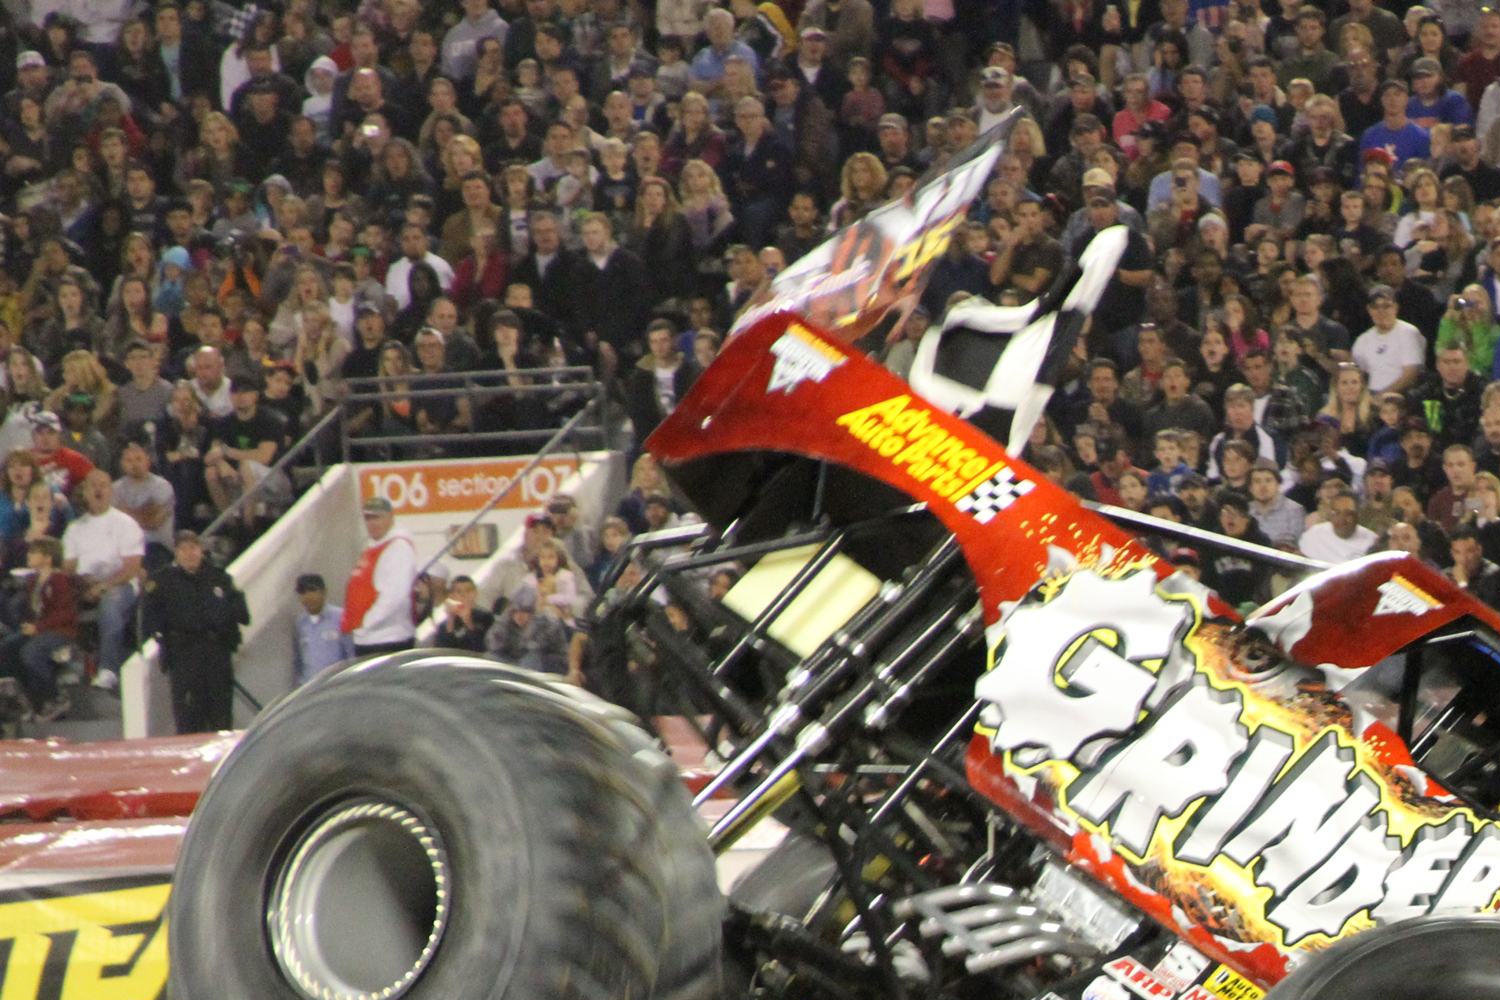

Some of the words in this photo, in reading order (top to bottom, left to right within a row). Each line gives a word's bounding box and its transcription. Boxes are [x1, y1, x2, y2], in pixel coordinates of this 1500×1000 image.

[835, 409, 907, 458] Auto
[891, 432, 967, 498] Parts
[863, 393, 989, 481] Advance
[369, 471, 428, 509] 106
[437, 472, 511, 498] section
[517, 463, 573, 502] 107
[1110, 960, 1173, 997] ARP
[1228, 977, 1259, 1000] Auto
